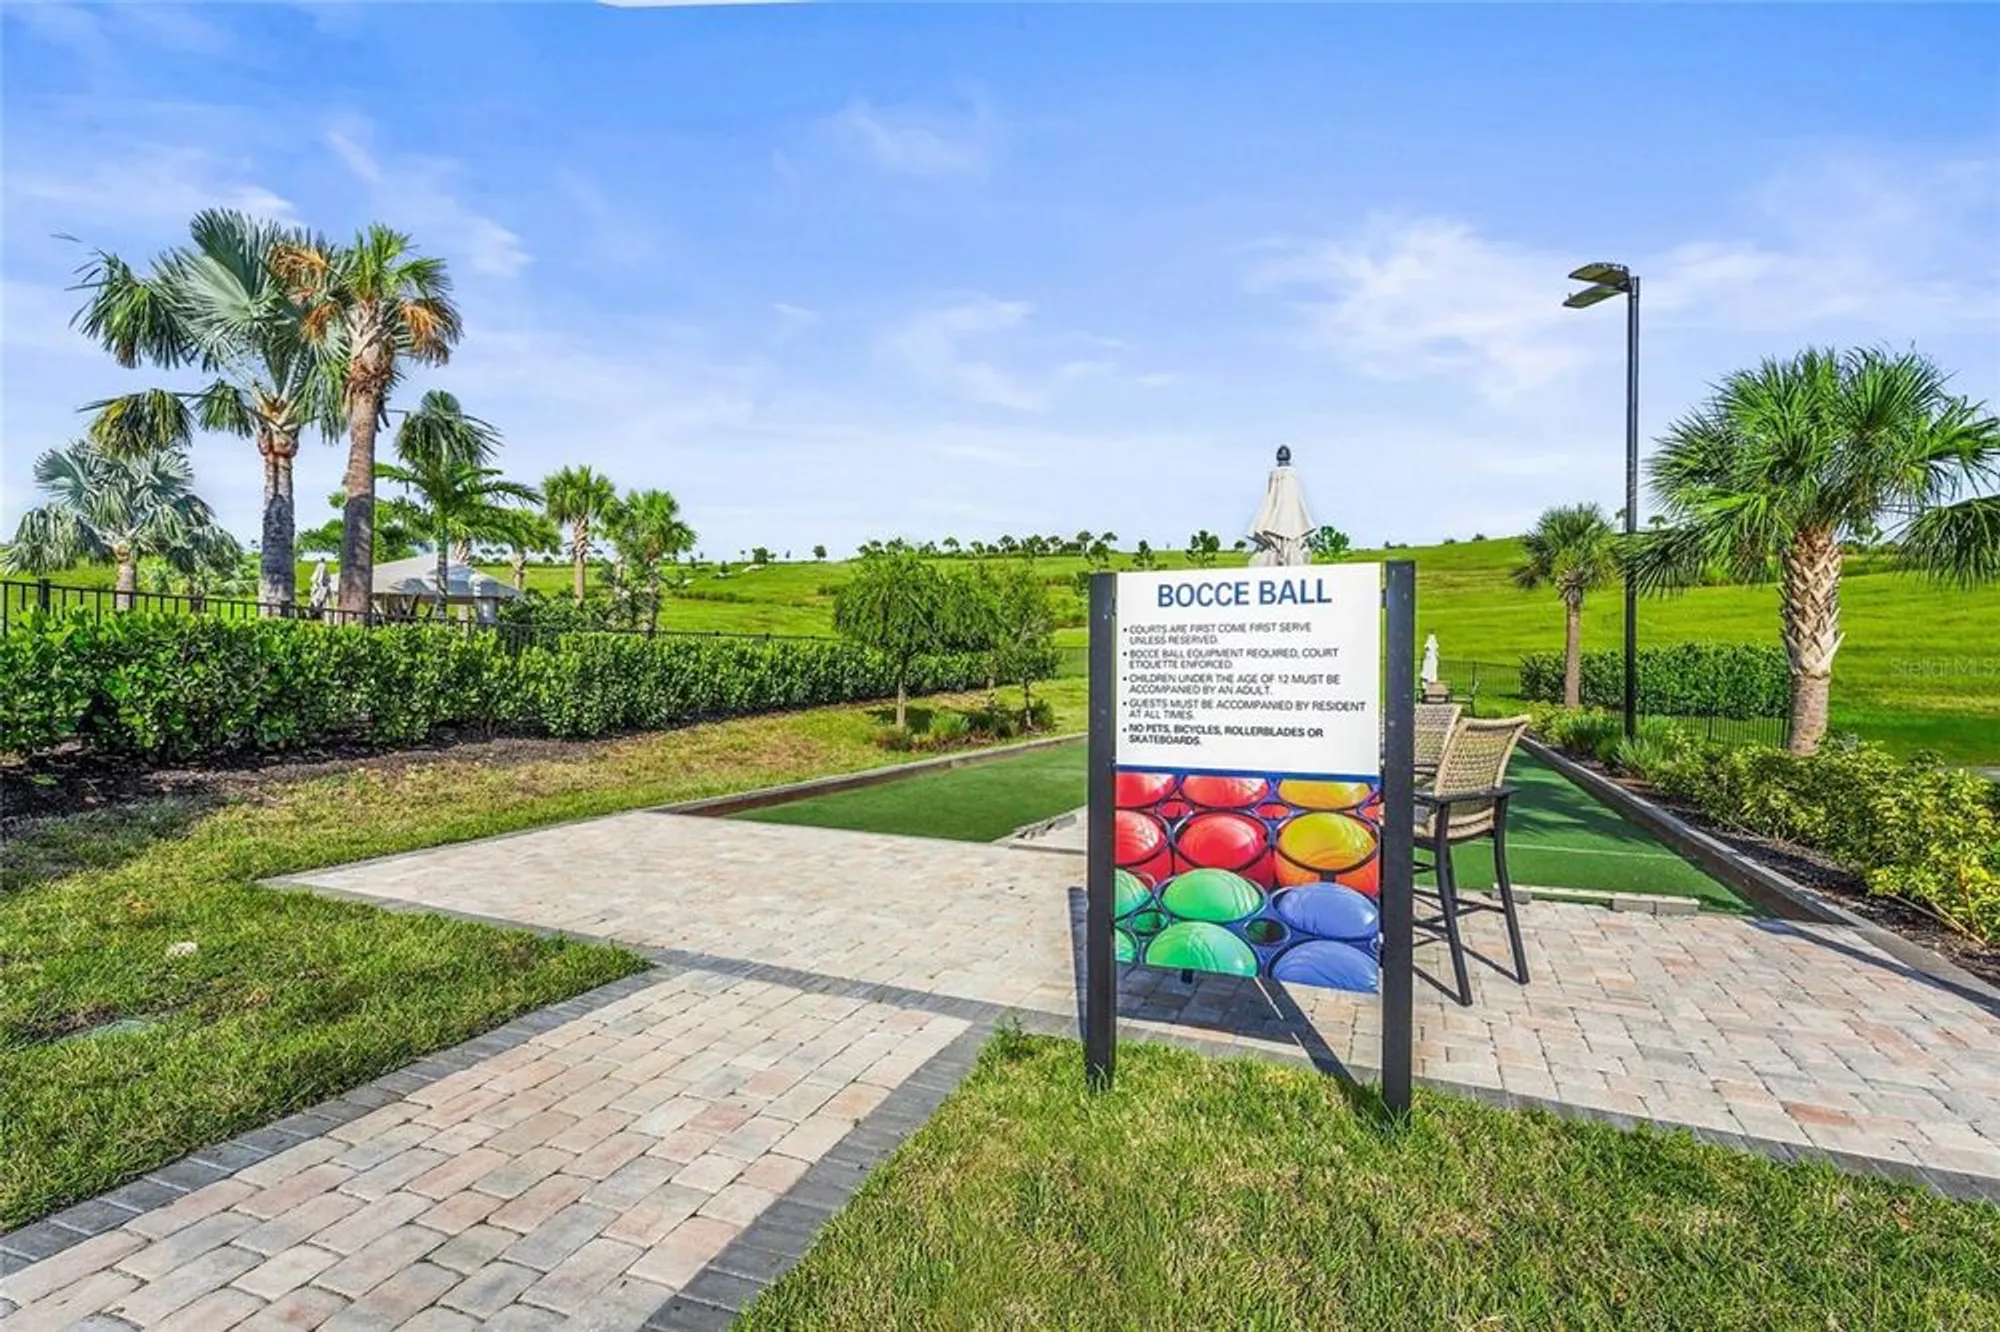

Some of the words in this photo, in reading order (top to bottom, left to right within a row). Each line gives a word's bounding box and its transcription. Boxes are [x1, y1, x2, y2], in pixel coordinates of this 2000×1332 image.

[1157, 581, 1250, 608] BOCCE
[1258, 578, 1332, 605] BALL
[1129, 624, 1168, 634] COURTS
[1170, 624, 1188, 633] ARE
[1190, 624, 1216, 633] FIRST
[1218, 624, 1246, 633] COME
[1249, 622, 1277, 633] FIRST
[1279, 622, 1311, 632] SERVE
[1129, 636, 1166, 645] UNLESS
[1130, 650, 1160, 658] BOCCE
[1162, 649, 1184, 658] BALL
[1187, 648, 1244, 659] EQUIPMENT
[1302, 648, 1338, 658] COURT
[1129, 660, 1178, 669] ETIQUETTE
[1129, 674, 1176, 683] CHILDREN
[1178, 674, 1213, 683] UNDER
[1215, 674, 1234, 683] THE
[1236, 675, 1258, 684] AGE
[1260, 675, 1274, 683] OF
[1278, 675, 1289, 684] 12
[1291, 675, 1324, 684] MUST
[1326, 675, 1340, 684] BE
[1128, 685, 1201, 694] ACCOMPANIED
[1202, 685, 1216, 694] BY
[1218, 686, 1233, 694] AN
[1235, 686, 1273, 695] ADULT.
[1129, 699, 1168, 708] GUESTS
[1170, 699, 1199, 709] MUST
[1201, 700, 1213, 709] BE
[1216, 700, 1293, 710] ACCOMPANIED
[1295, 701, 1309, 710] BY
[1312, 701, 1366, 712] RESIDENT
[1129, 710, 1141, 718] AT
[1144, 710, 1161, 719] ALL
[1164, 710, 1194, 720] TIMES.
[1129, 724, 1144, 732] NO
[1174, 725, 1222, 735] BICYCLES,
[1224, 726, 1305, 737] ROLLERBLADES
[1307, 728, 1324, 738] OR
[1128, 735, 1201, 746] SKATEBOARDS.
